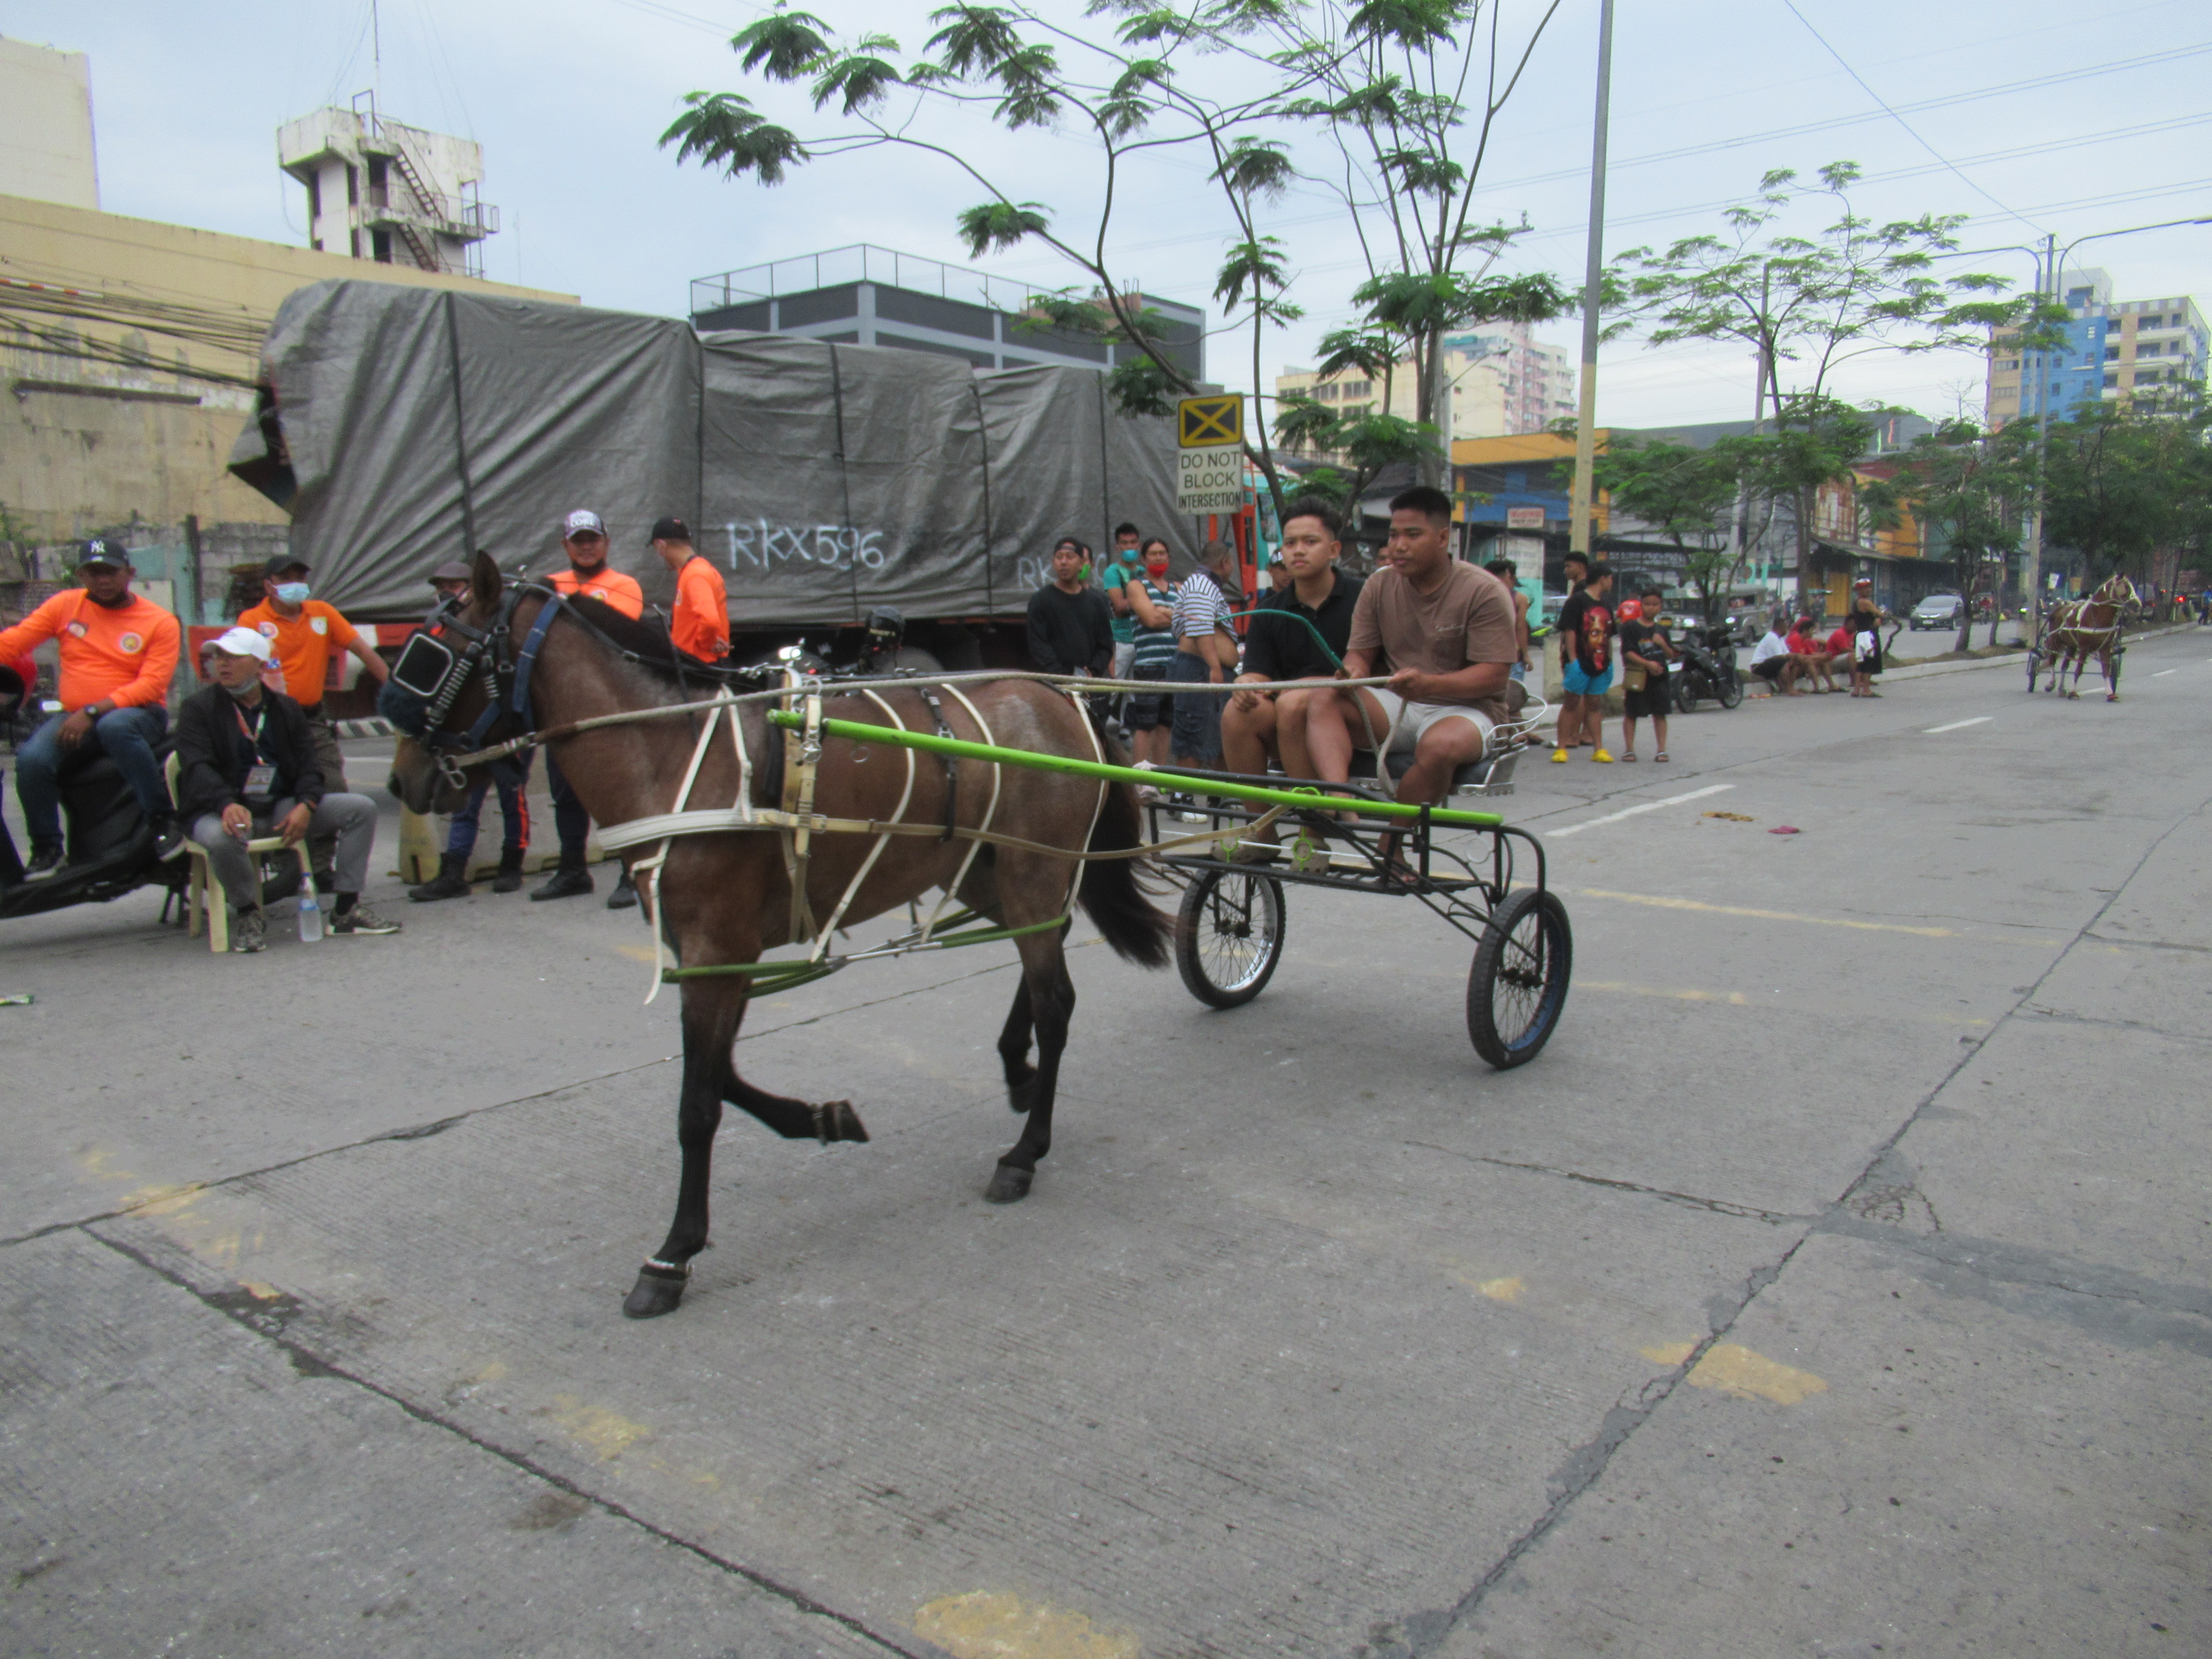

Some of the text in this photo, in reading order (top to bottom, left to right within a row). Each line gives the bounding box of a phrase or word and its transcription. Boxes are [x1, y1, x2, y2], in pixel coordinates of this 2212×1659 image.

[1182, 451, 1240, 469] DO NOT
[1185, 471, 1236, 488] BLOCK
[1179, 492, 1242, 509] INTERSECTION
[726, 517, 885, 571] RKX596
